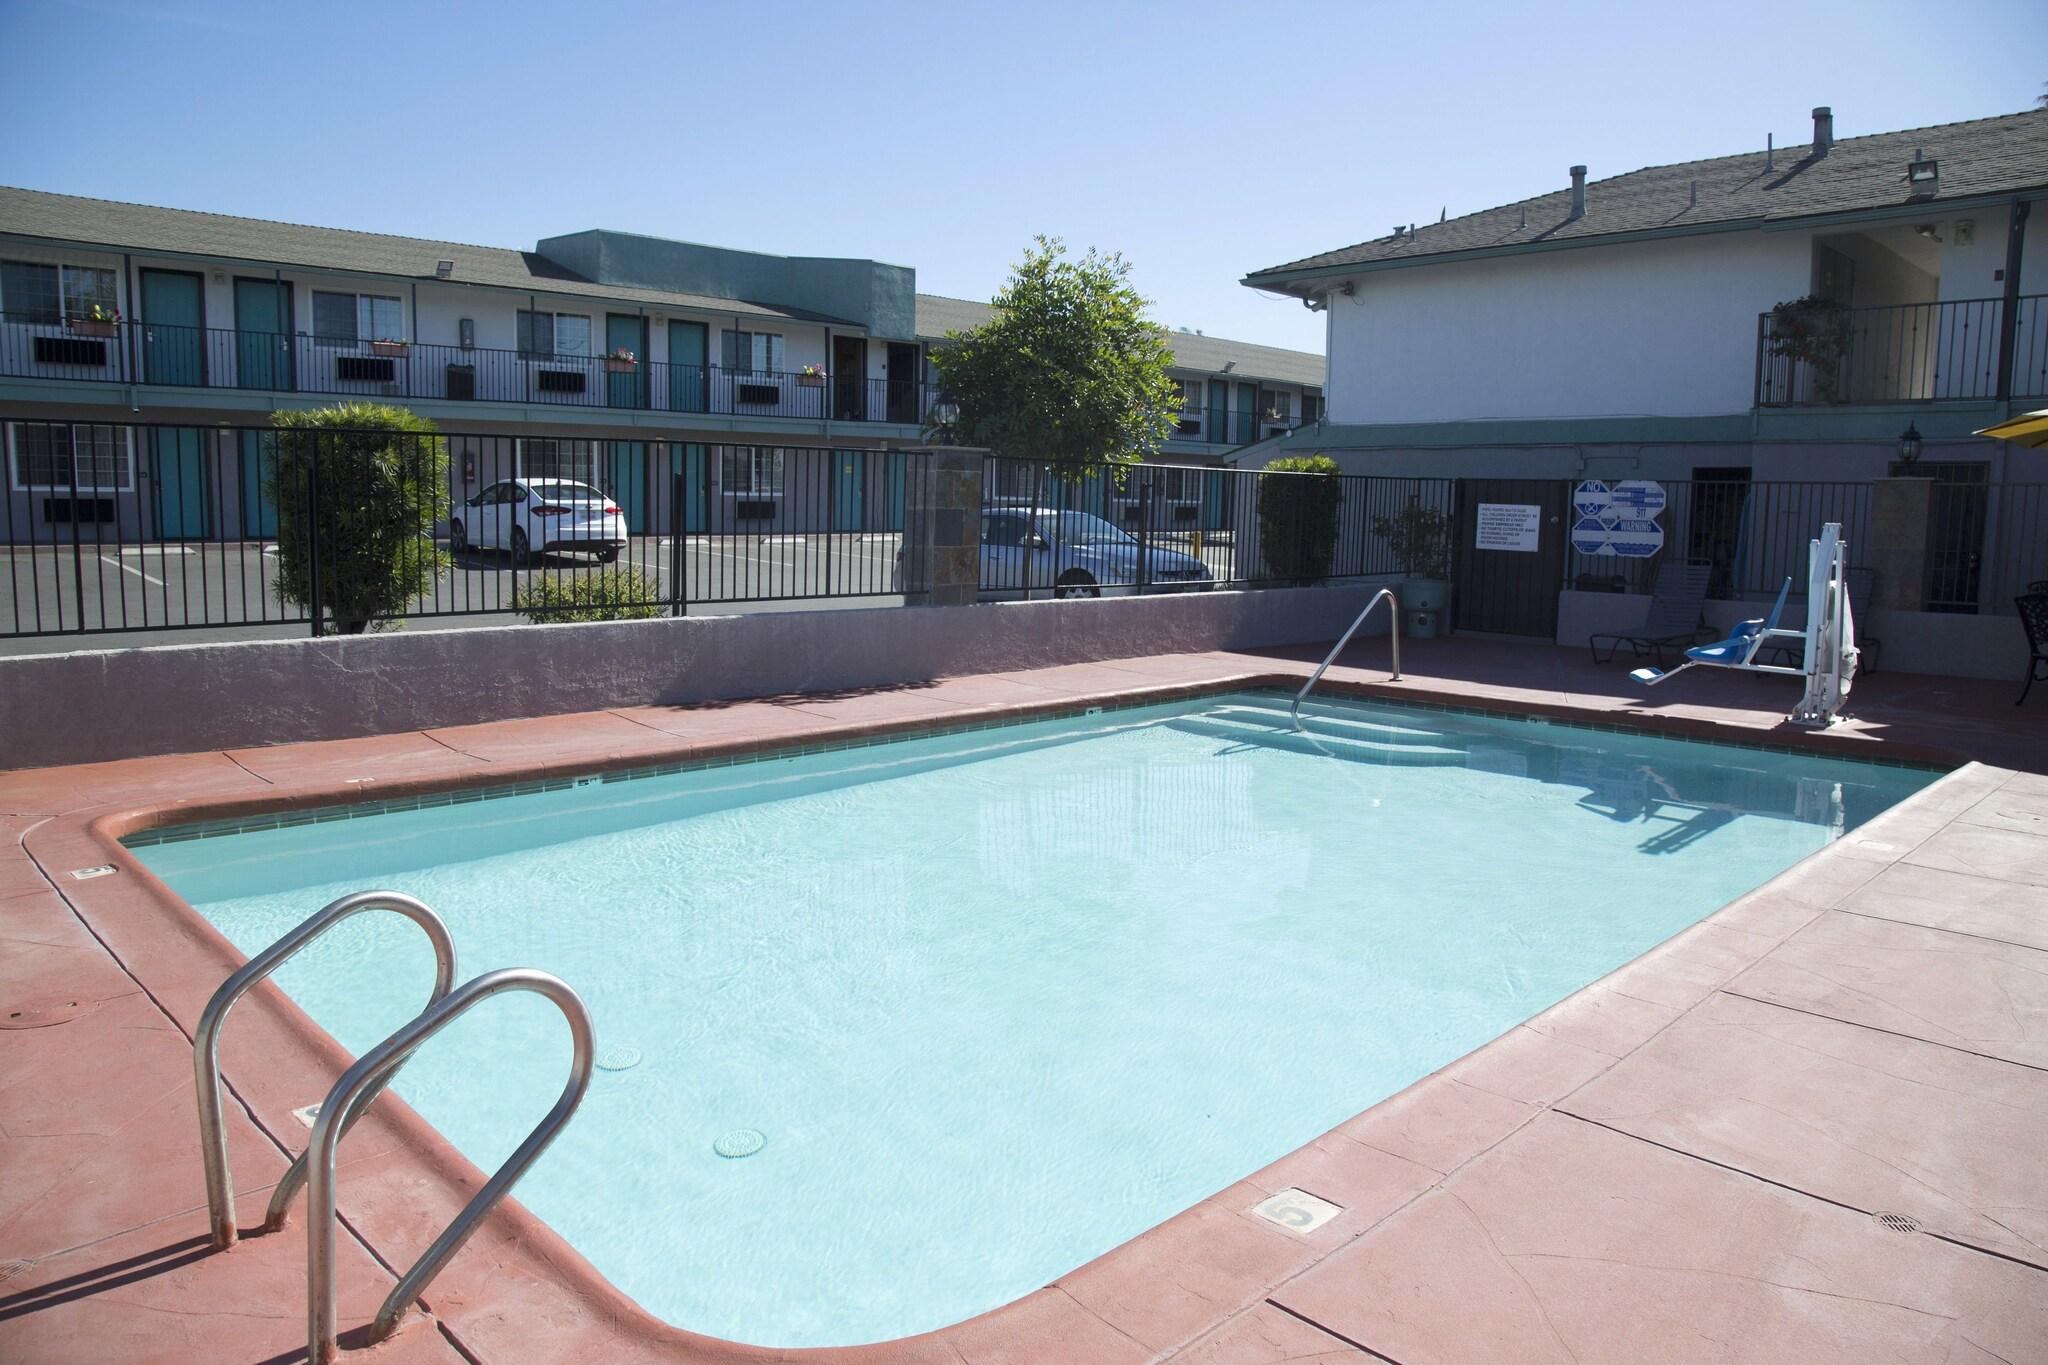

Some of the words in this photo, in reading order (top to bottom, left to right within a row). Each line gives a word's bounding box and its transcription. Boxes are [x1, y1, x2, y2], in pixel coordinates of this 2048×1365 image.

[1587, 482, 1600, 492] NO
[1636, 508, 1646, 518] 911
[1620, 520, 1651, 532] WARNING
[1264, 1195, 1313, 1227] 5
